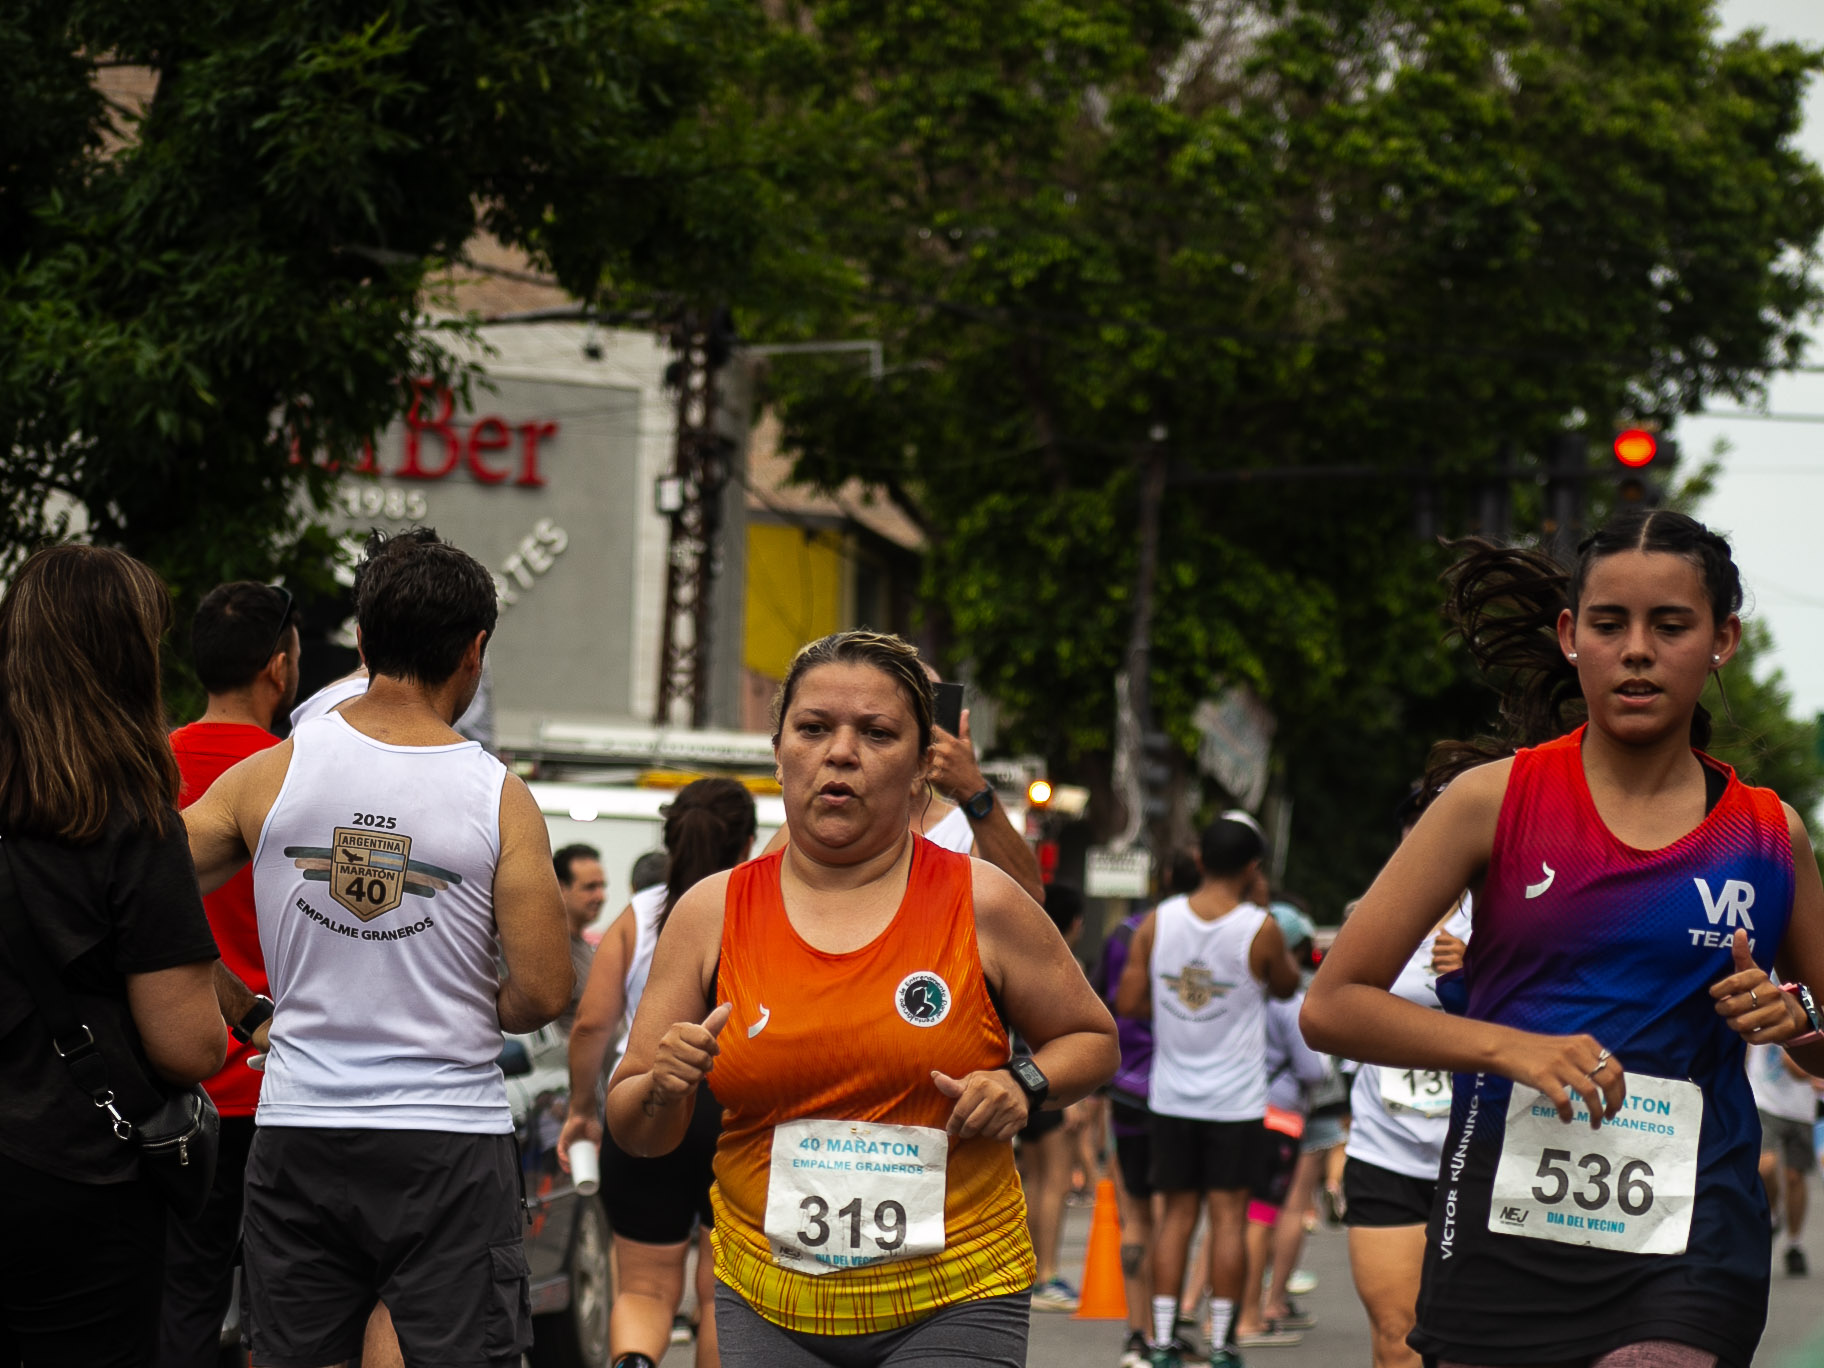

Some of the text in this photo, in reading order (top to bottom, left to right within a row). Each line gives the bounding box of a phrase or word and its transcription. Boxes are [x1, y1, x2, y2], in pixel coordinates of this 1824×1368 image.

[352, 812, 398, 830] 2025
[341, 835, 401, 852] ARGENTINA
[339, 865, 396, 881] MARATÓN
[345, 876, 387, 905] 40
[1693, 877, 1756, 931] VR
[295, 897, 435, 941] EMPALME GRANEROS
[799, 1137, 920, 1157] 40 MARATON
[792, 1158, 924, 1175] EMPALME GRANEROS
[1531, 1147, 1655, 1217] 536
[796, 1195, 907, 1250] 319
[1441, 1189, 1458, 1261] VICTOR
[1499, 1206, 1530, 1223] NEJ
[1546, 1211, 1626, 1234] DIA DEL VECINO
[833, 1254, 849, 1267] DEL
